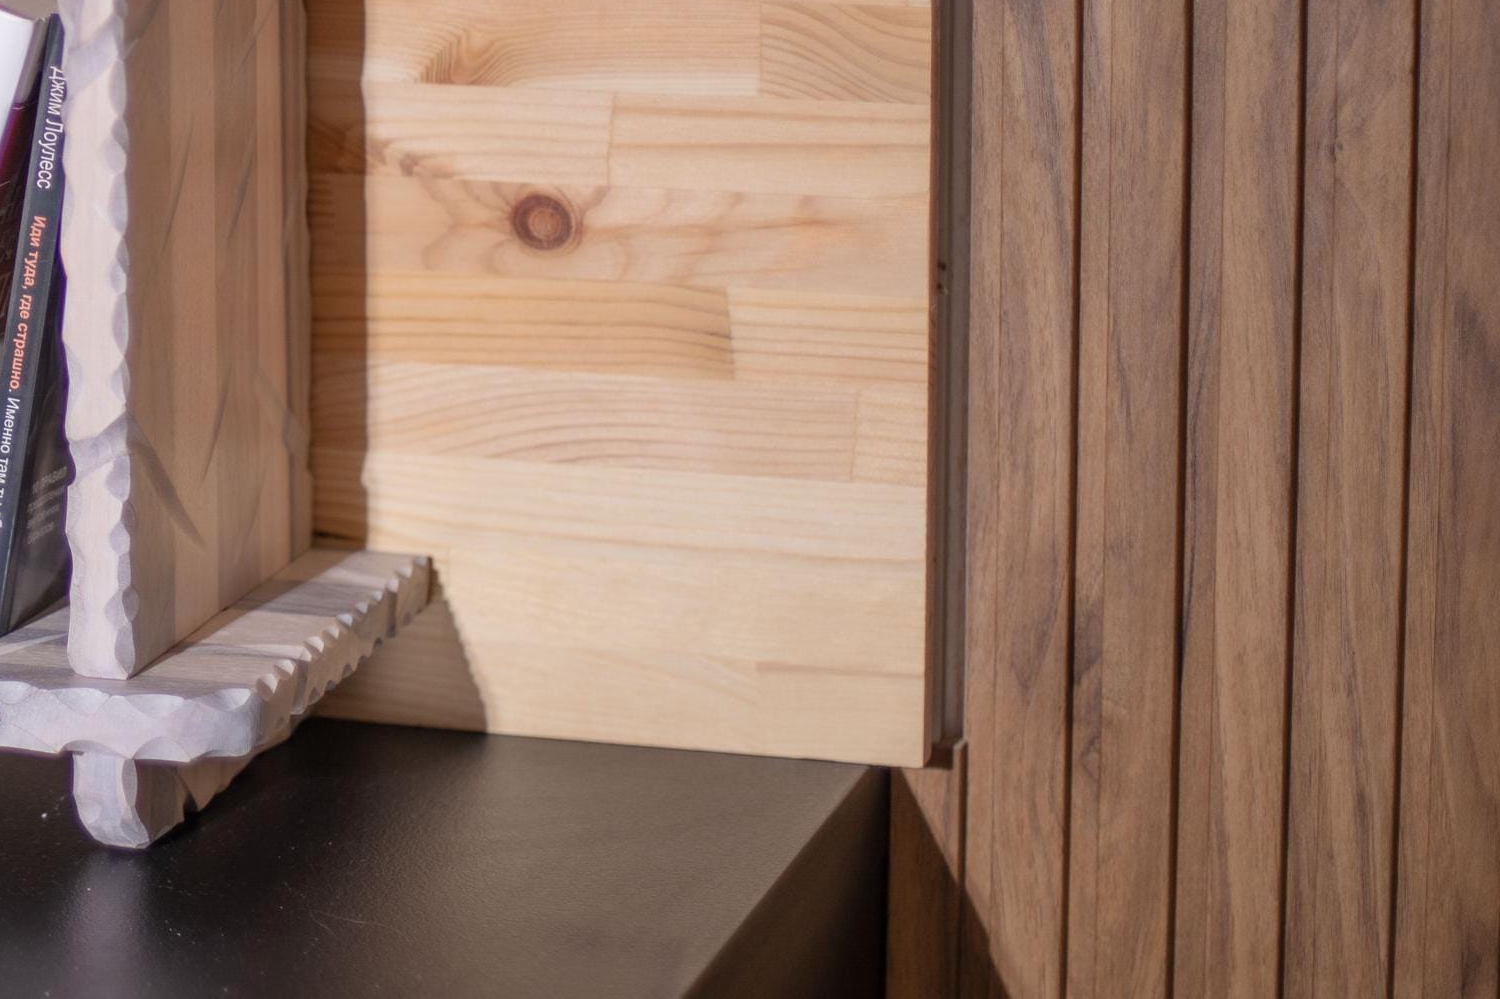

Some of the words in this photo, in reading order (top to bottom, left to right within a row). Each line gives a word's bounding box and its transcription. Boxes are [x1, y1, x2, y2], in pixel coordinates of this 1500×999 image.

[48, 65, 68, 116] Джим
[36, 118, 65, 190] Лоулесс
[29, 215, 47, 247] Иди
[21, 250, 40, 290] туда,
[18, 294, 33, 320] где
[0, 397, 21, 454] Именно
